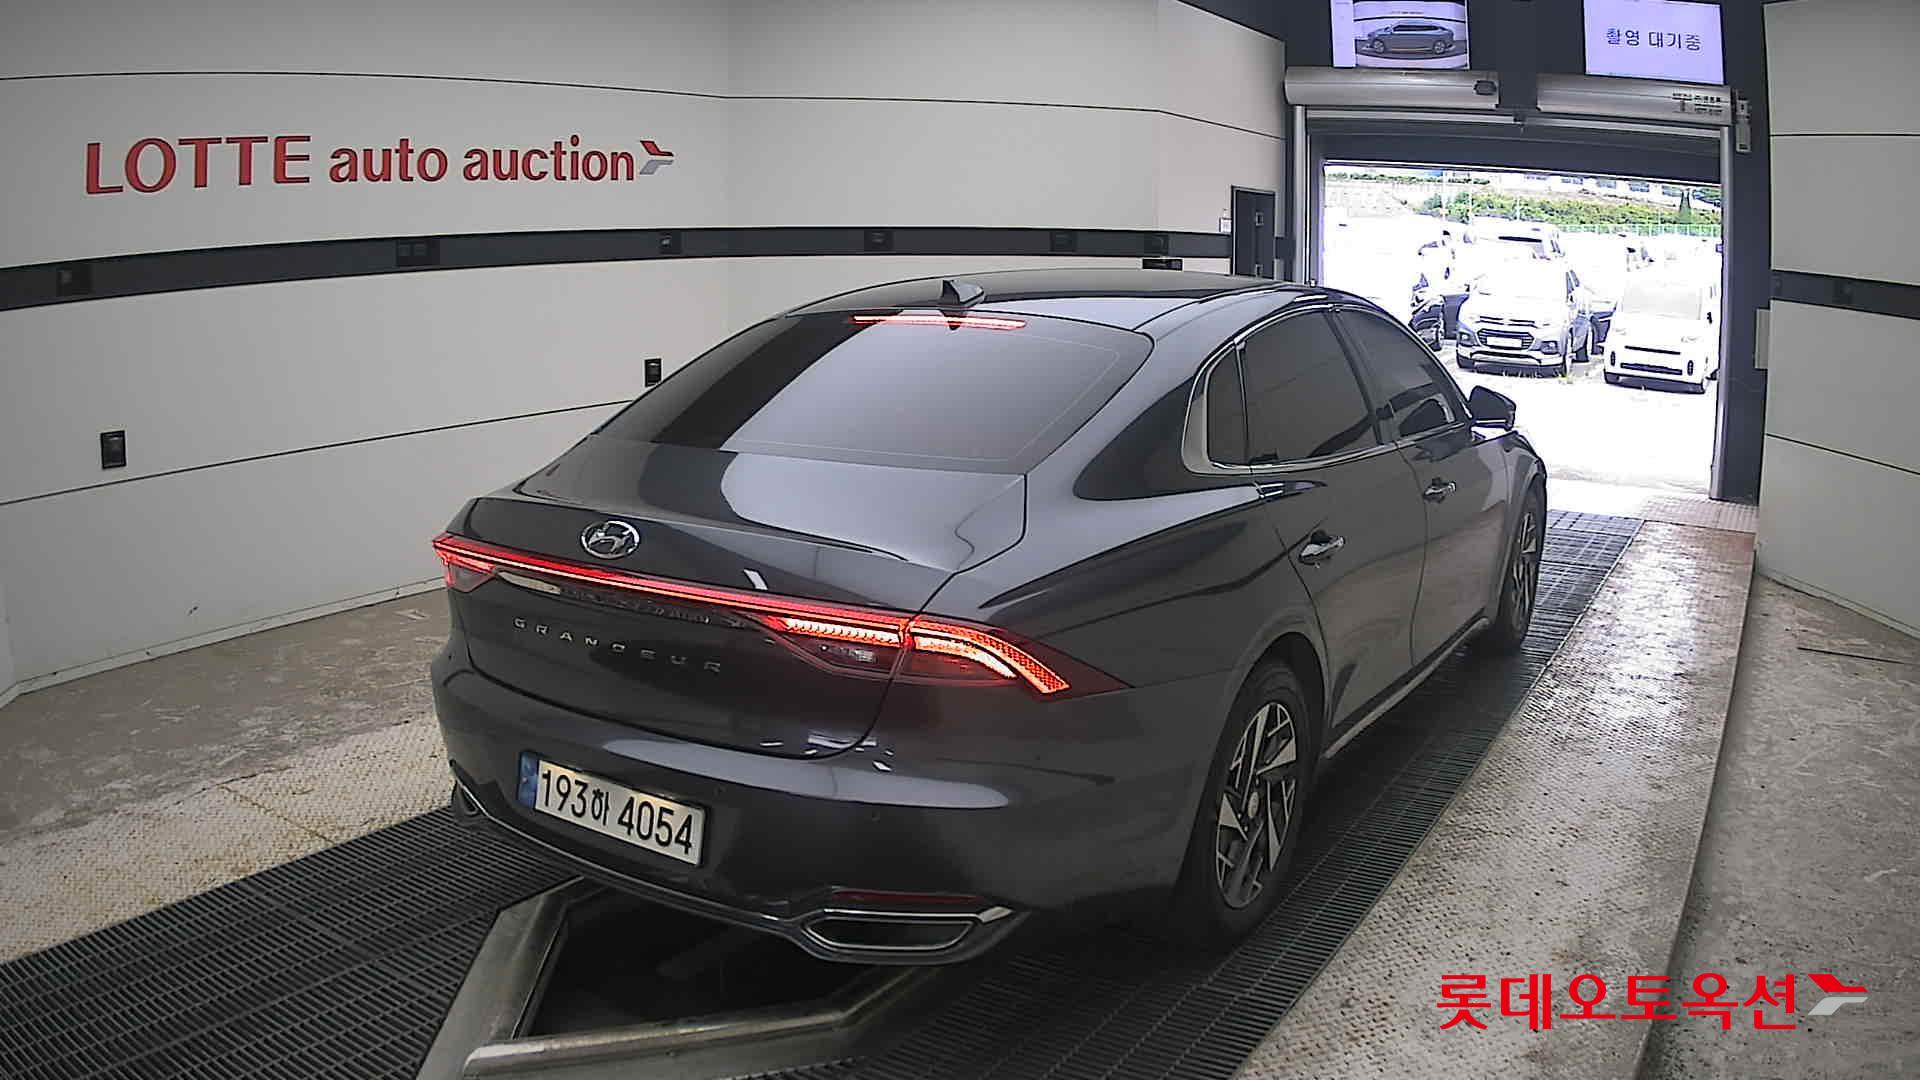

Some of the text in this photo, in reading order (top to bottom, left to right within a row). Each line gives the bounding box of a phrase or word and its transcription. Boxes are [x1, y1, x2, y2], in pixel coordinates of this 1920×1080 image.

[85, 135, 634, 195] LOTTE auto auction
[513, 616, 721, 673] GRANDEUR
[542, 770, 692, 854] 193하 4054
